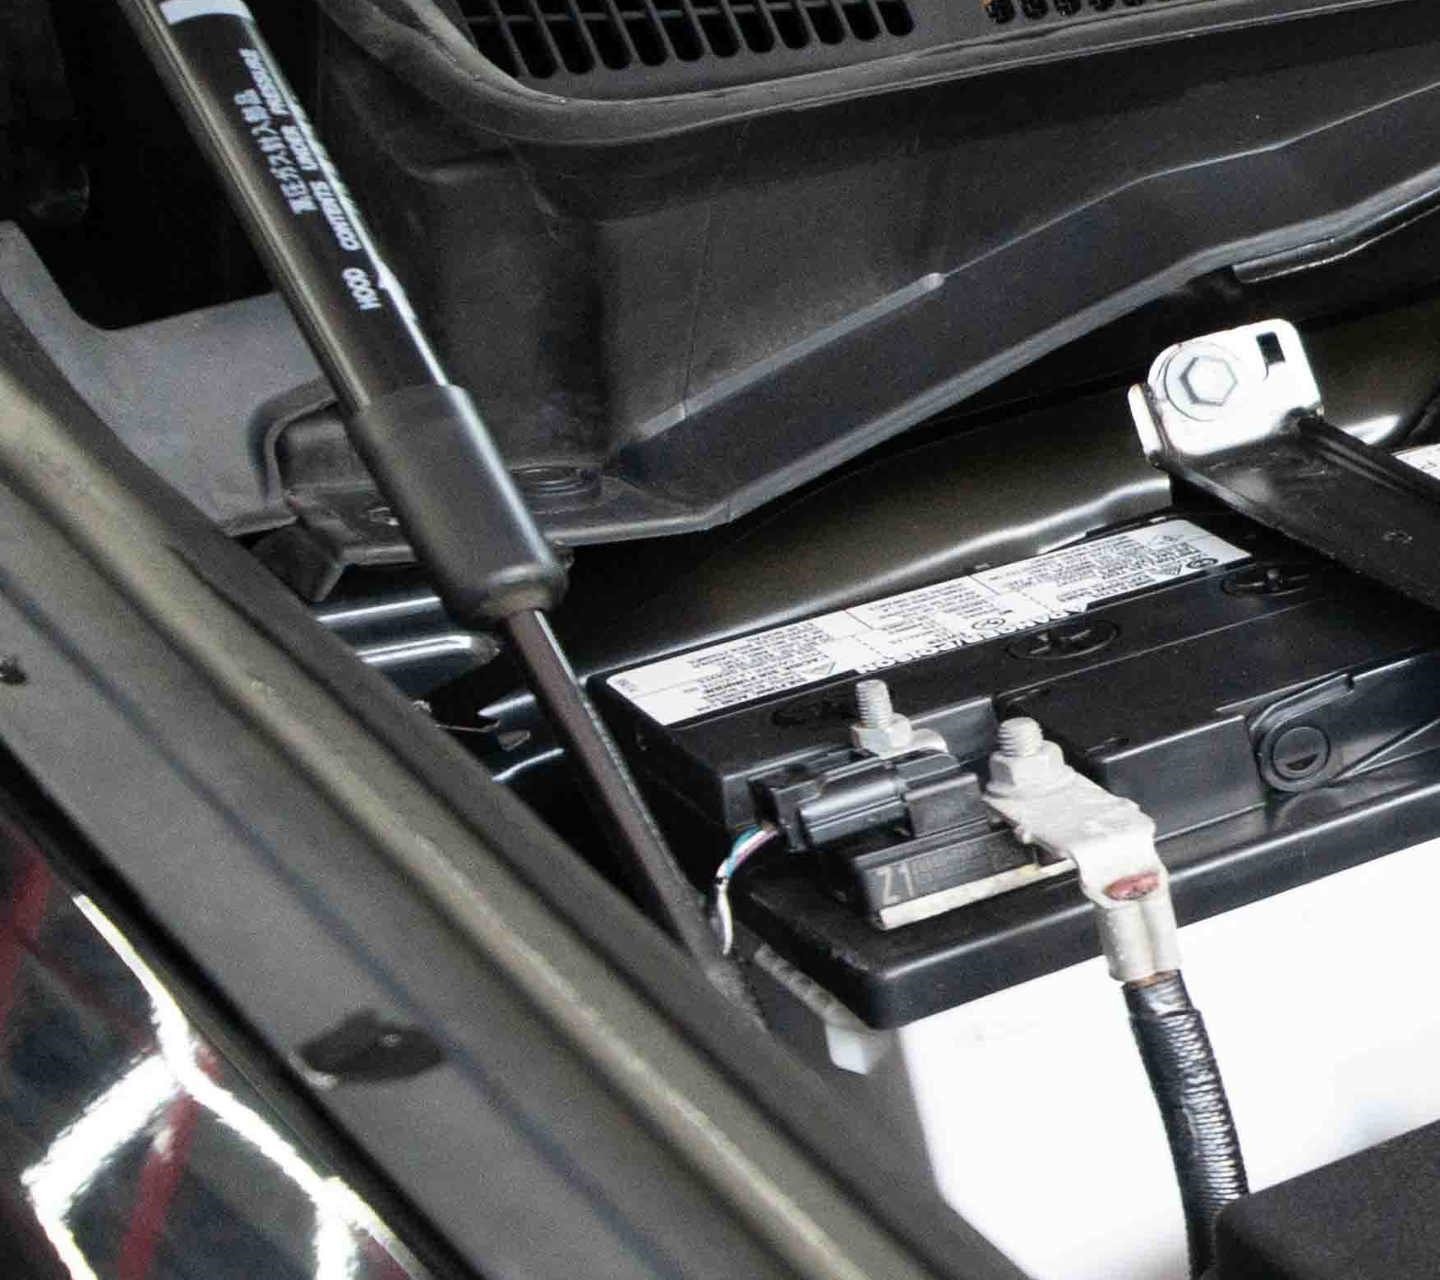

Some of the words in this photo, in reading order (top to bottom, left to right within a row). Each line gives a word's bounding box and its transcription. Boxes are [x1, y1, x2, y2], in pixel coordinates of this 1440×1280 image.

[237, 47, 290, 118] PRESSURE
[308, 180, 362, 251] CONTENTS
[341, 266, 382, 311] HOOD
